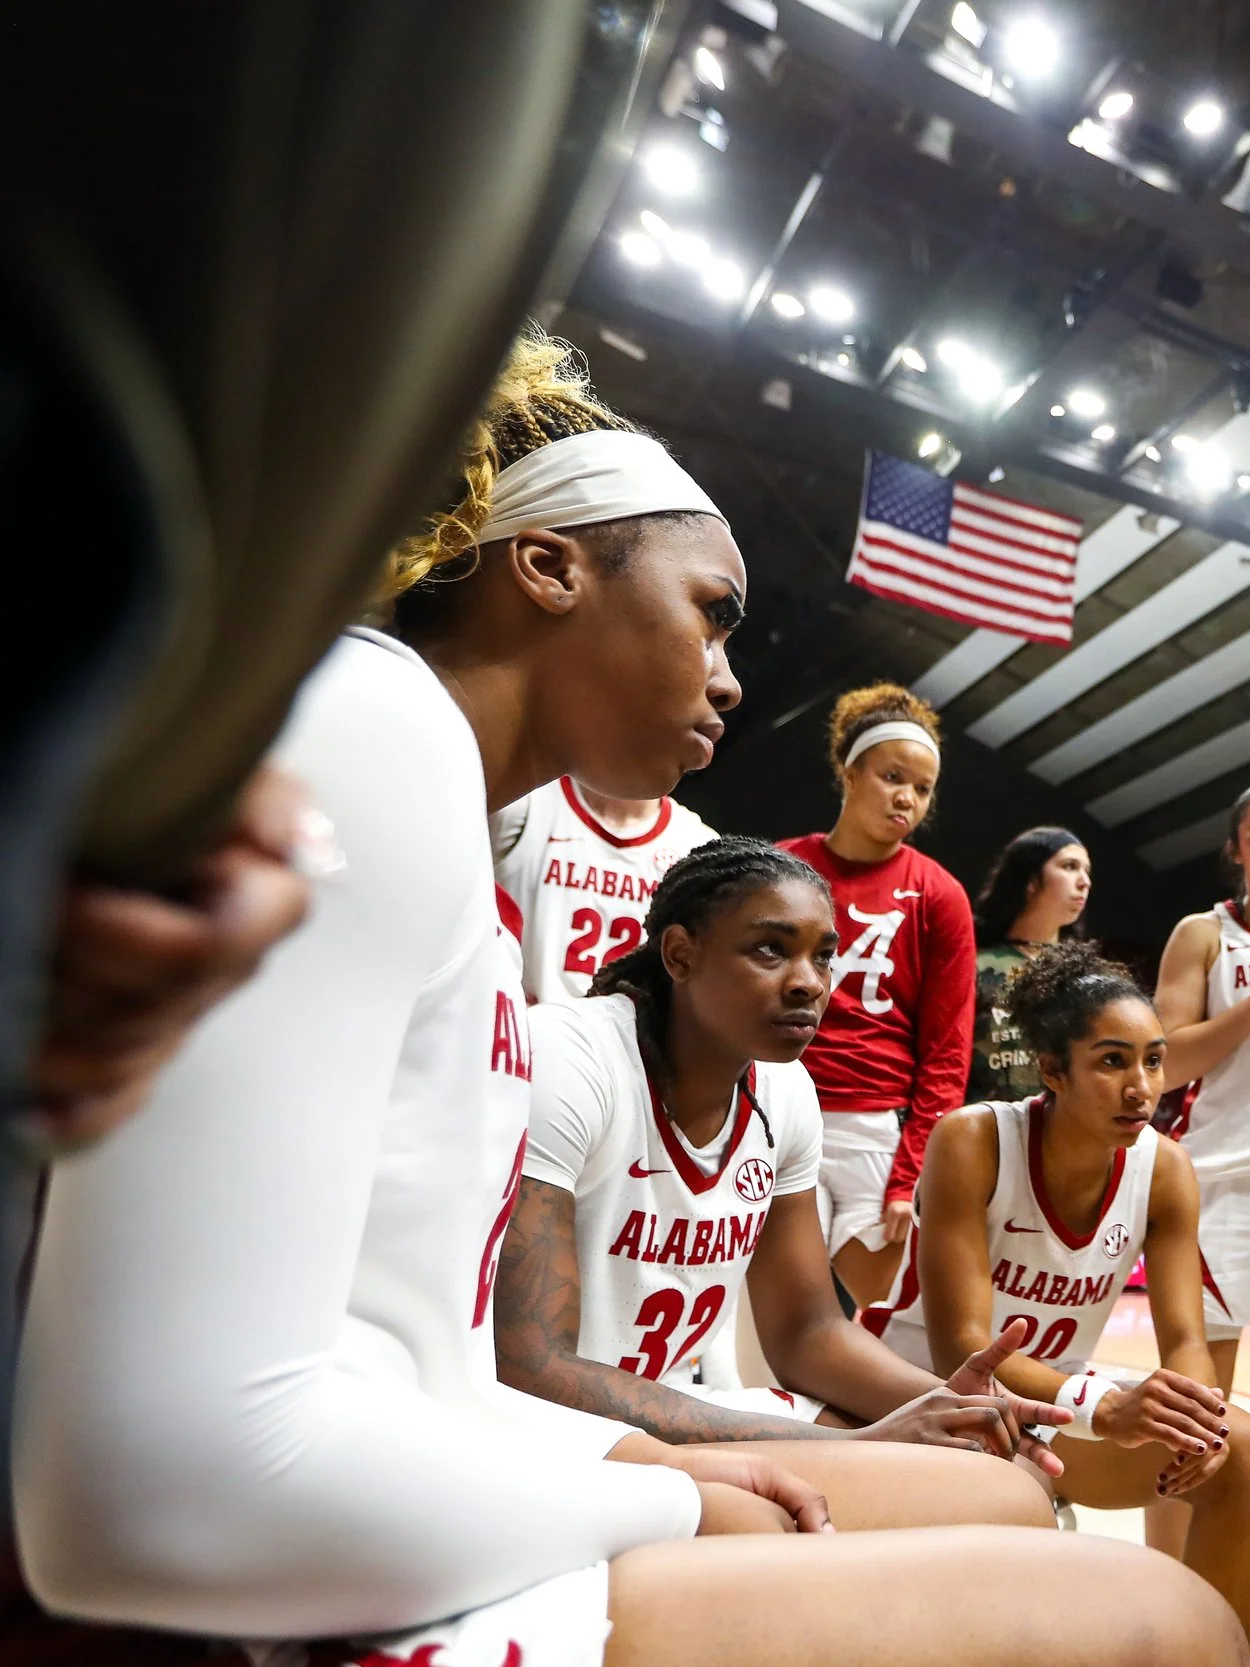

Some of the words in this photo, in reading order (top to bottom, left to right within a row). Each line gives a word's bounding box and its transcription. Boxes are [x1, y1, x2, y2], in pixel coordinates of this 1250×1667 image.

[544, 859, 659, 904] ALABAM
[563, 907, 642, 976] 22
[736, 1158, 774, 1201] SEC
[608, 1210, 767, 1266] ALABAMA
[991, 1258, 1115, 1307] ALABAMA
[618, 1285, 726, 1382] 32
